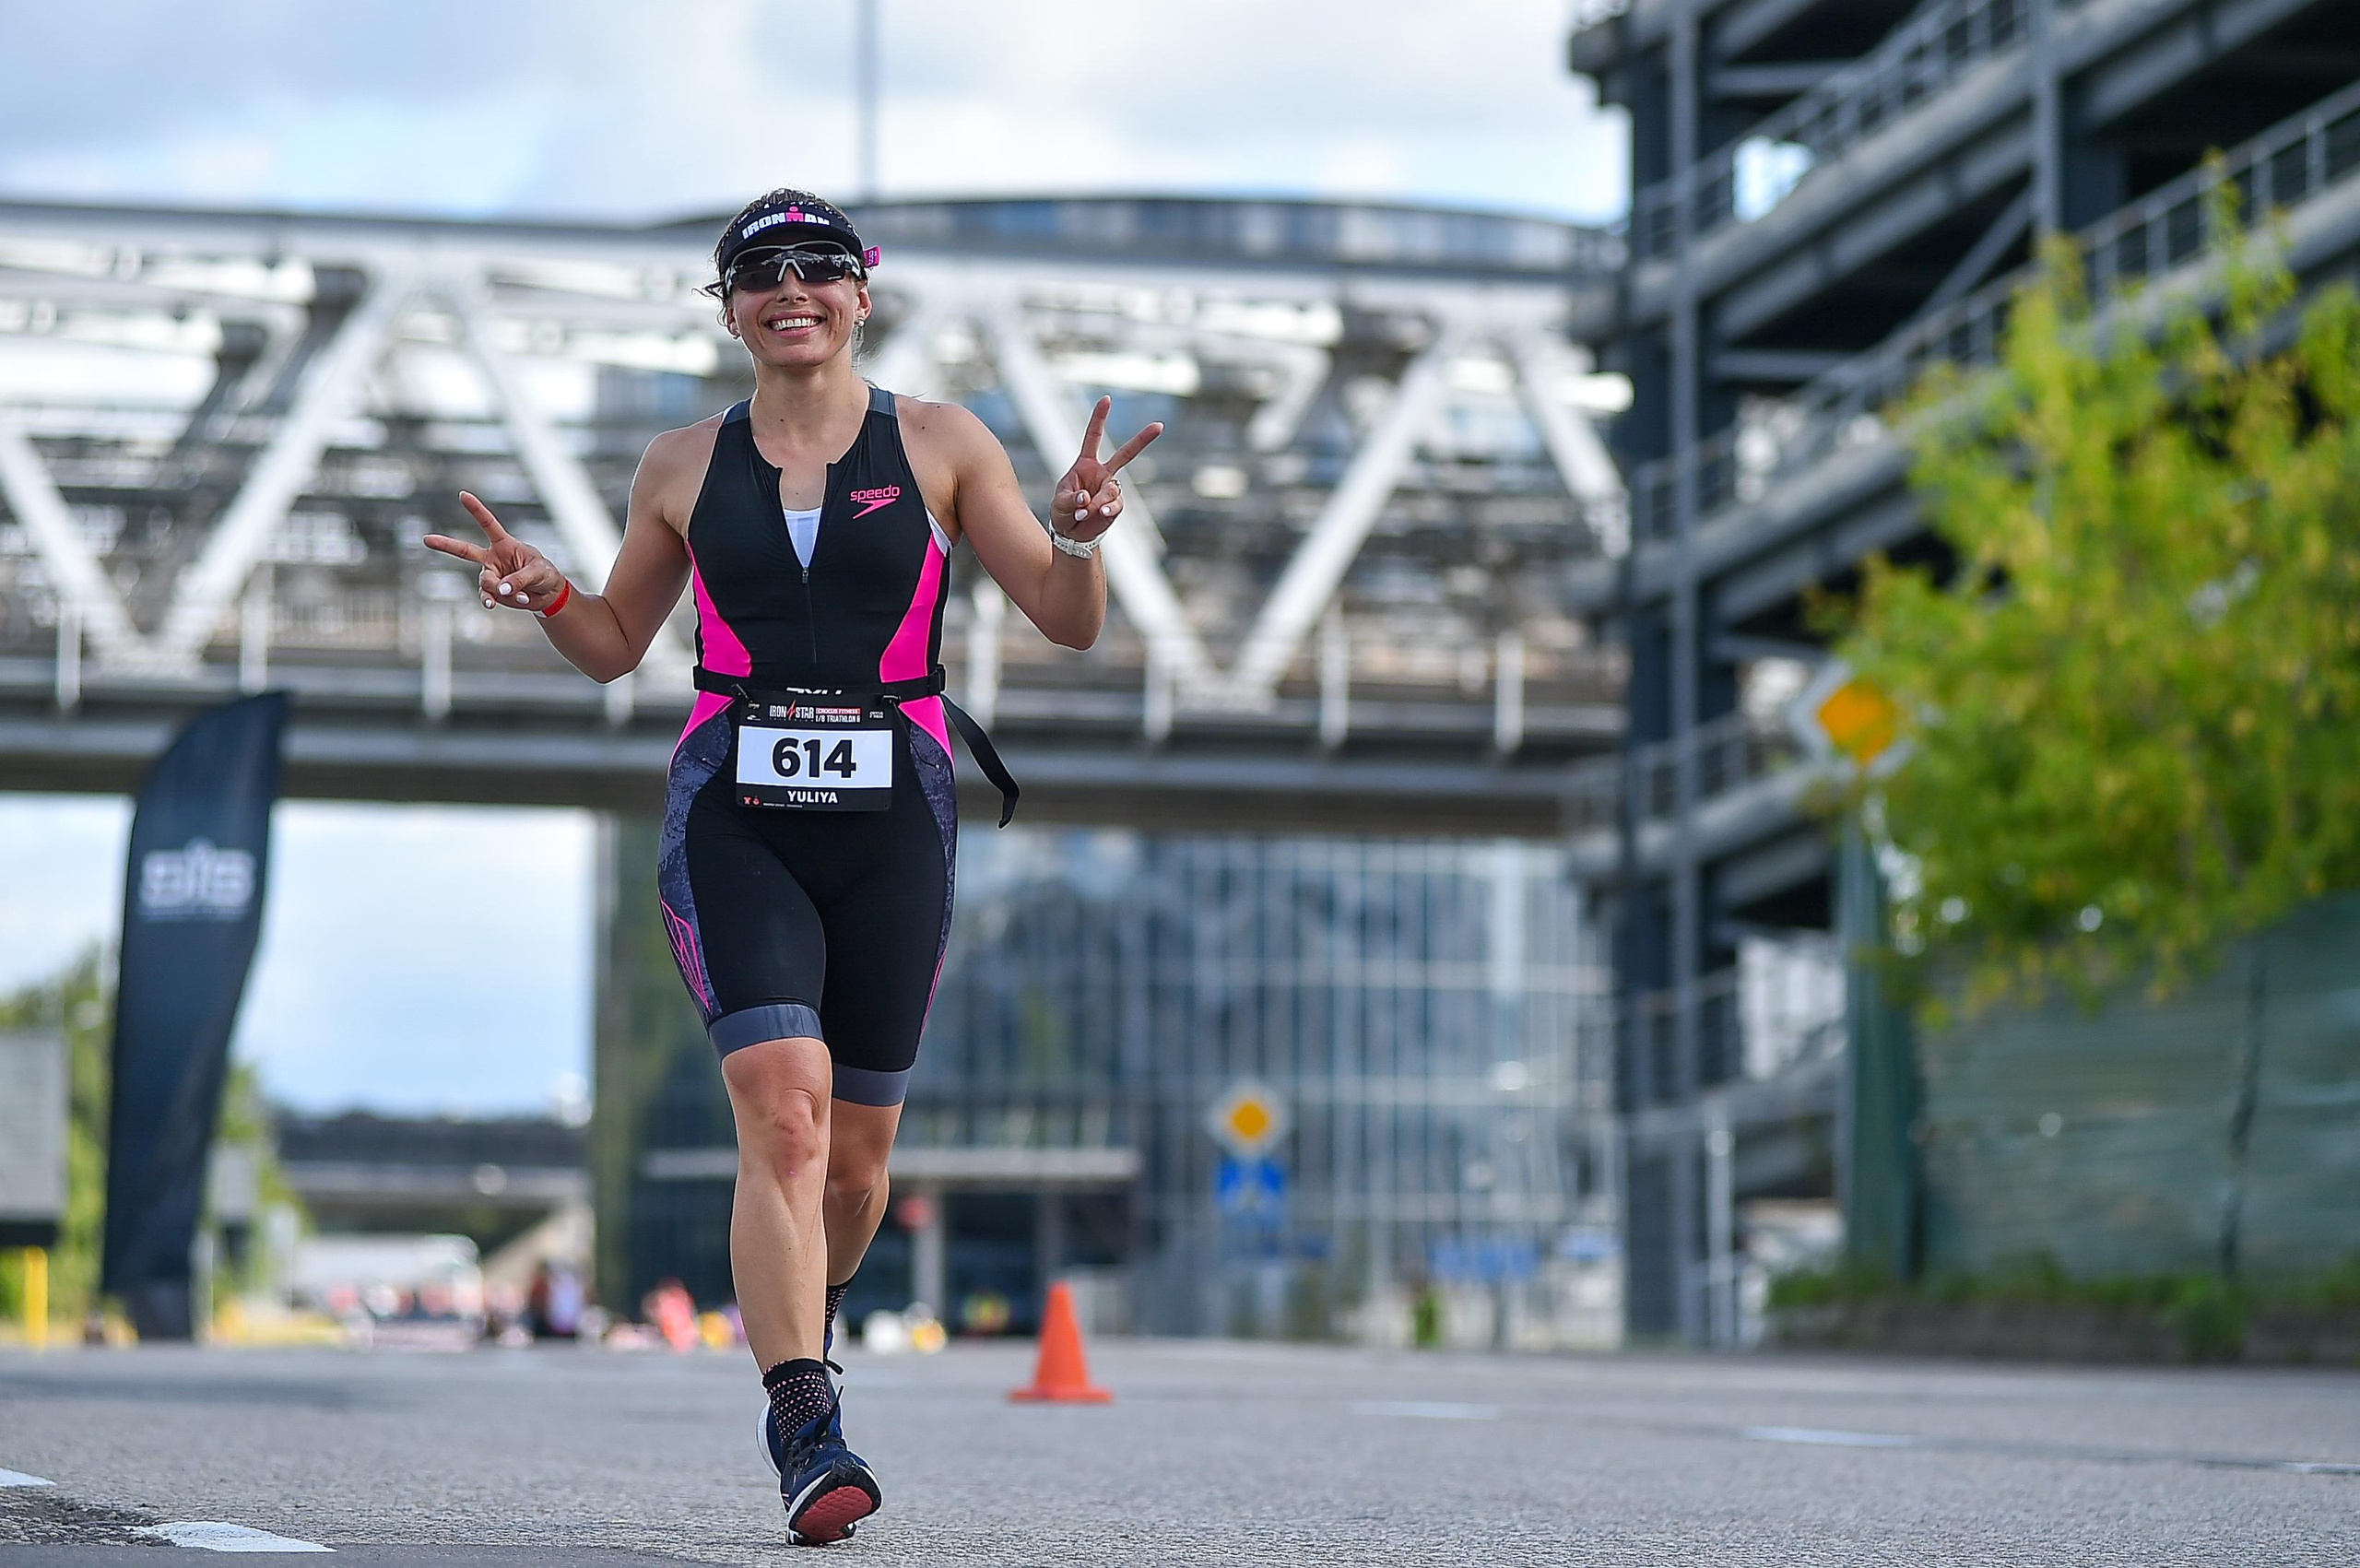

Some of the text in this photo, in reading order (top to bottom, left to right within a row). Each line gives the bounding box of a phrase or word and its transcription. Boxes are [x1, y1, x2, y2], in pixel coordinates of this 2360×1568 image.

[742, 206, 830, 240] IRONMAN
[850, 484, 900, 502] speedo
[770, 705, 787, 717] IRON
[796, 706, 814, 719] STAR
[773, 737, 856, 779] 614
[787, 790, 838, 804] YULIYA
